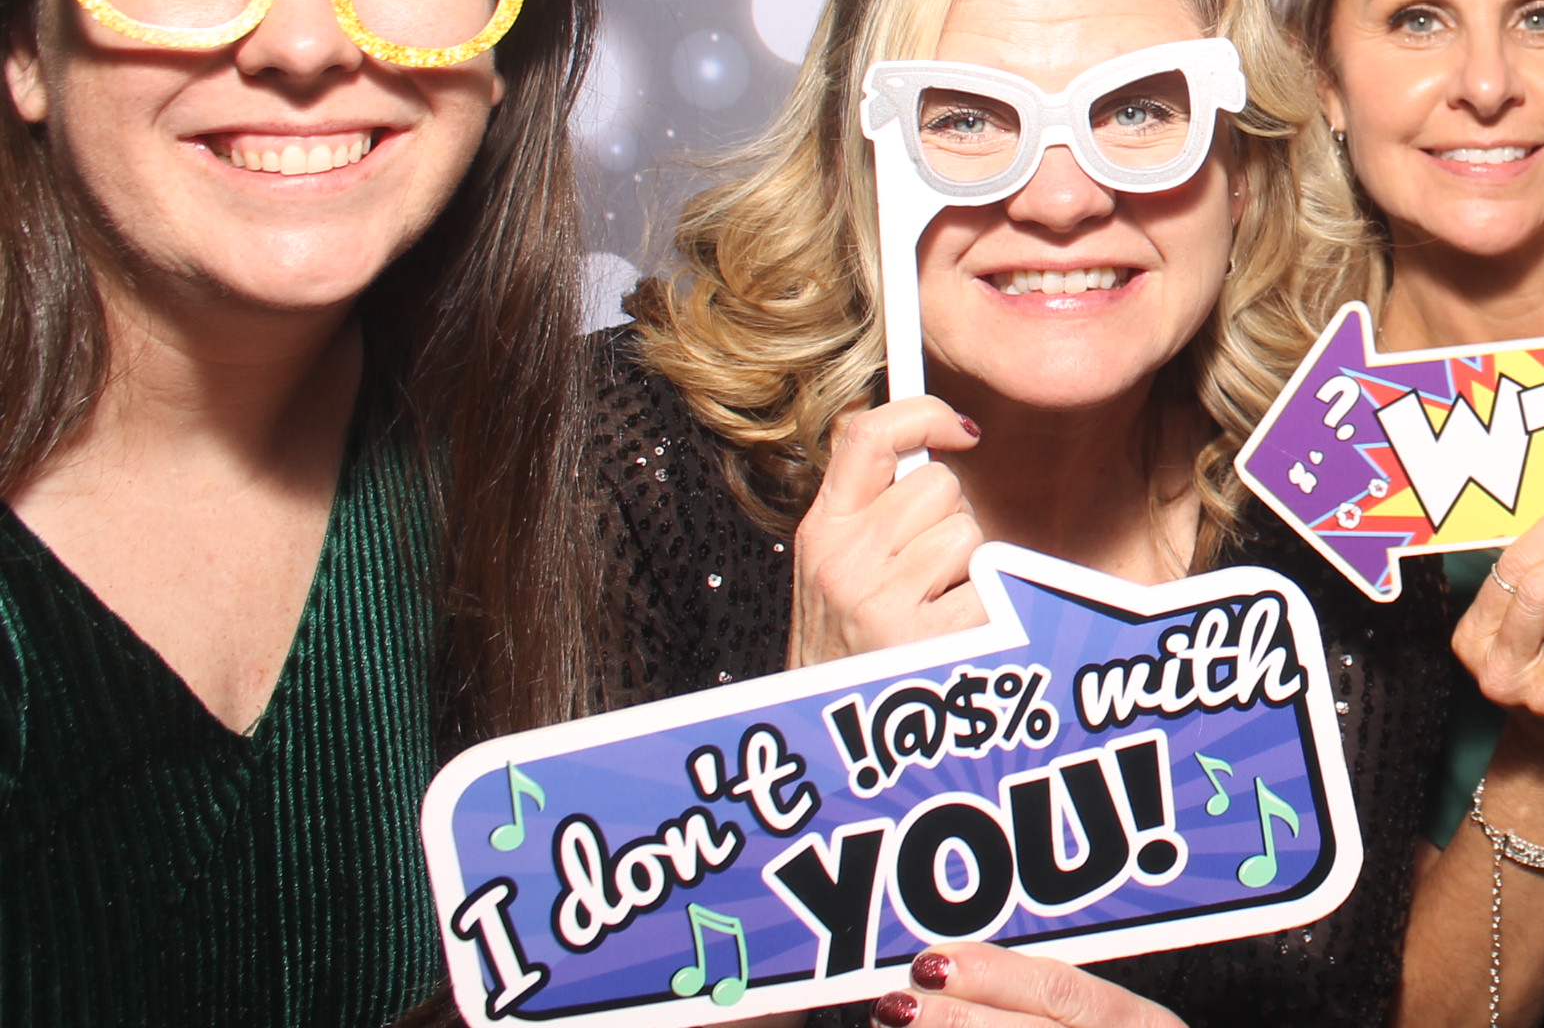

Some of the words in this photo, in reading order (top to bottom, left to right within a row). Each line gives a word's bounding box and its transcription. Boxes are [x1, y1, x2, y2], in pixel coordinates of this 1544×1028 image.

[454, 880, 547, 1018] I
[555, 726, 819, 950] don't
[1078, 593, 1303, 729] with
[774, 740, 1178, 978] YOU!
